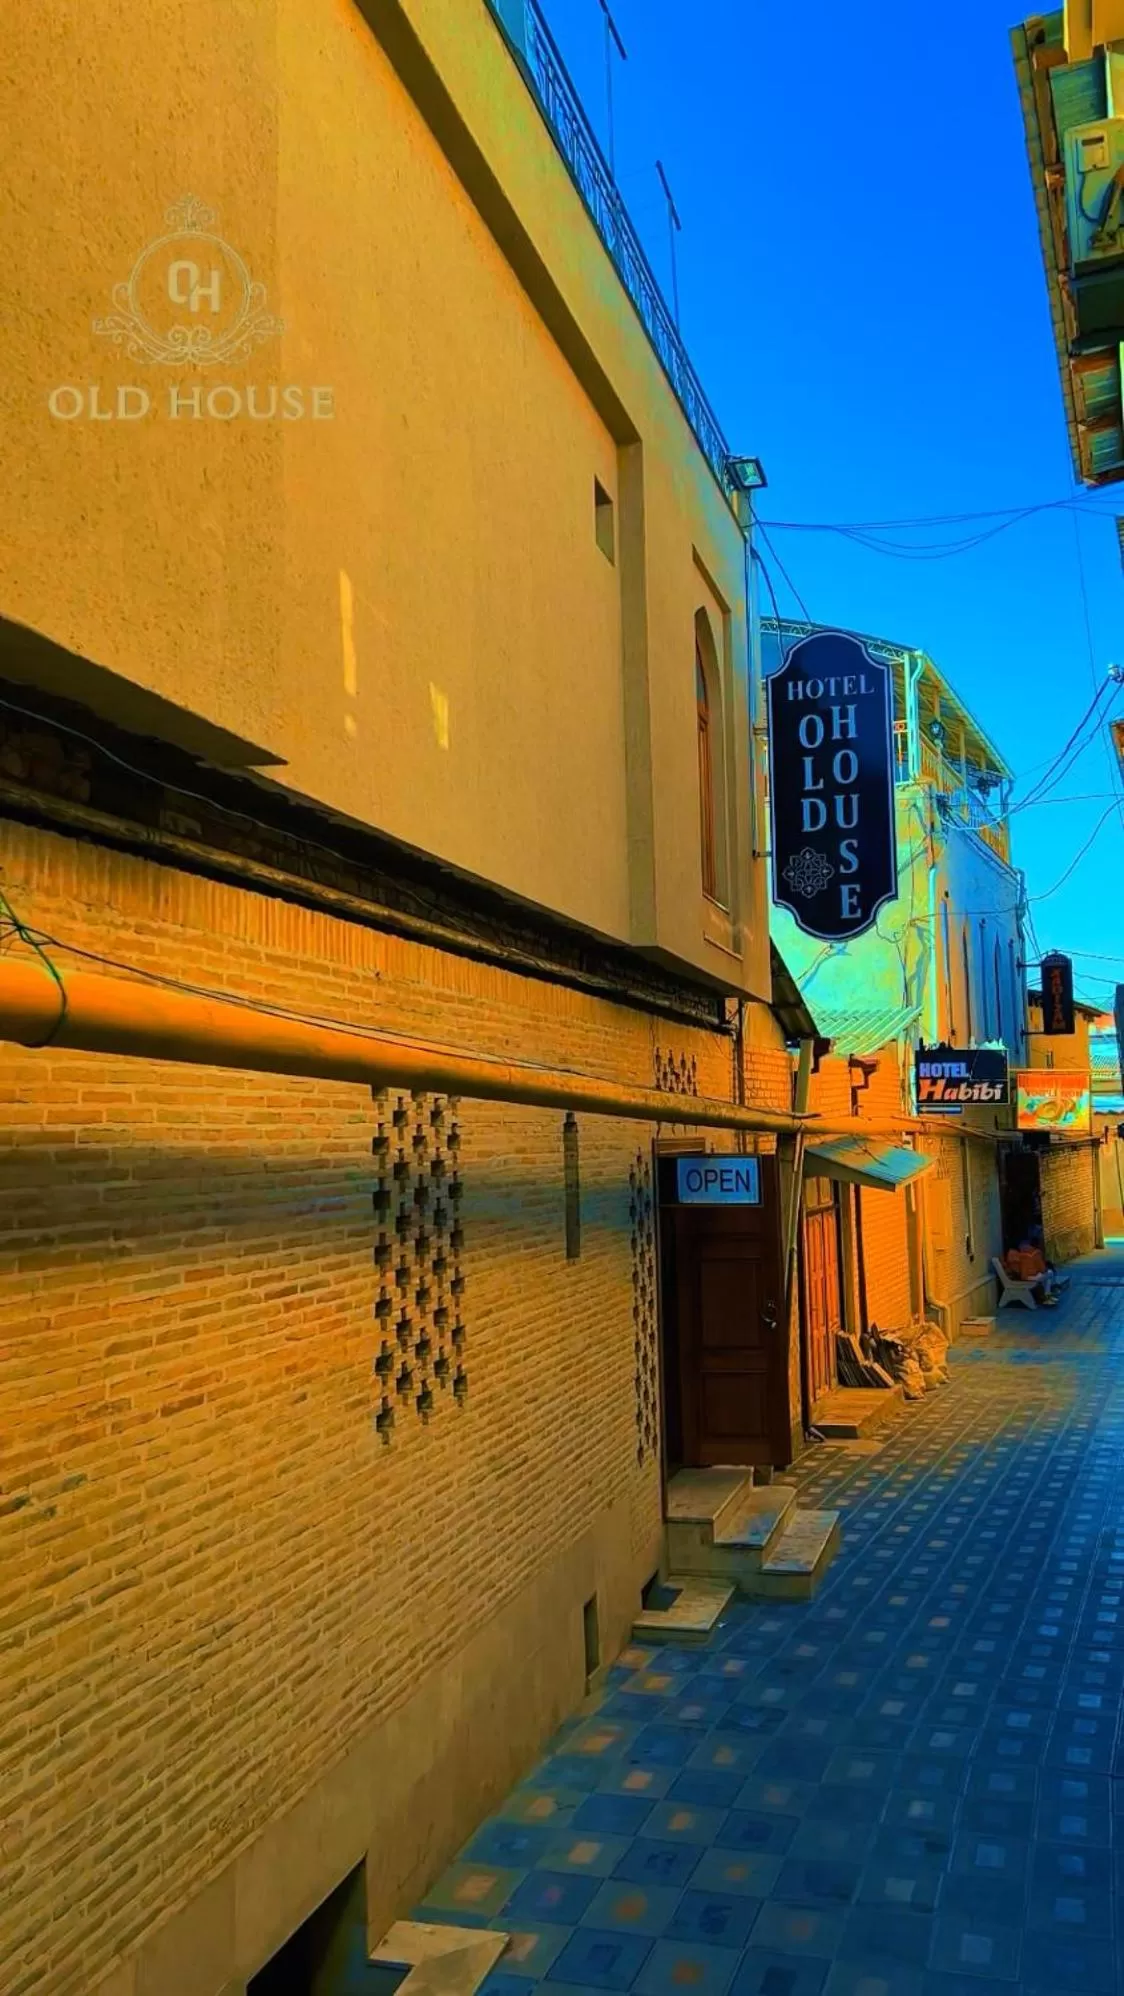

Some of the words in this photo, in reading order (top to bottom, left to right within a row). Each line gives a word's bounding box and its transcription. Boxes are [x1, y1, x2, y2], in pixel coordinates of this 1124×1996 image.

[787, 674, 875, 701] HOTEL
[919, 1062, 969, 1078] HOTEL
[918, 1079, 1004, 1101] Habibi
[686, 1168, 751, 1193] OPEN
